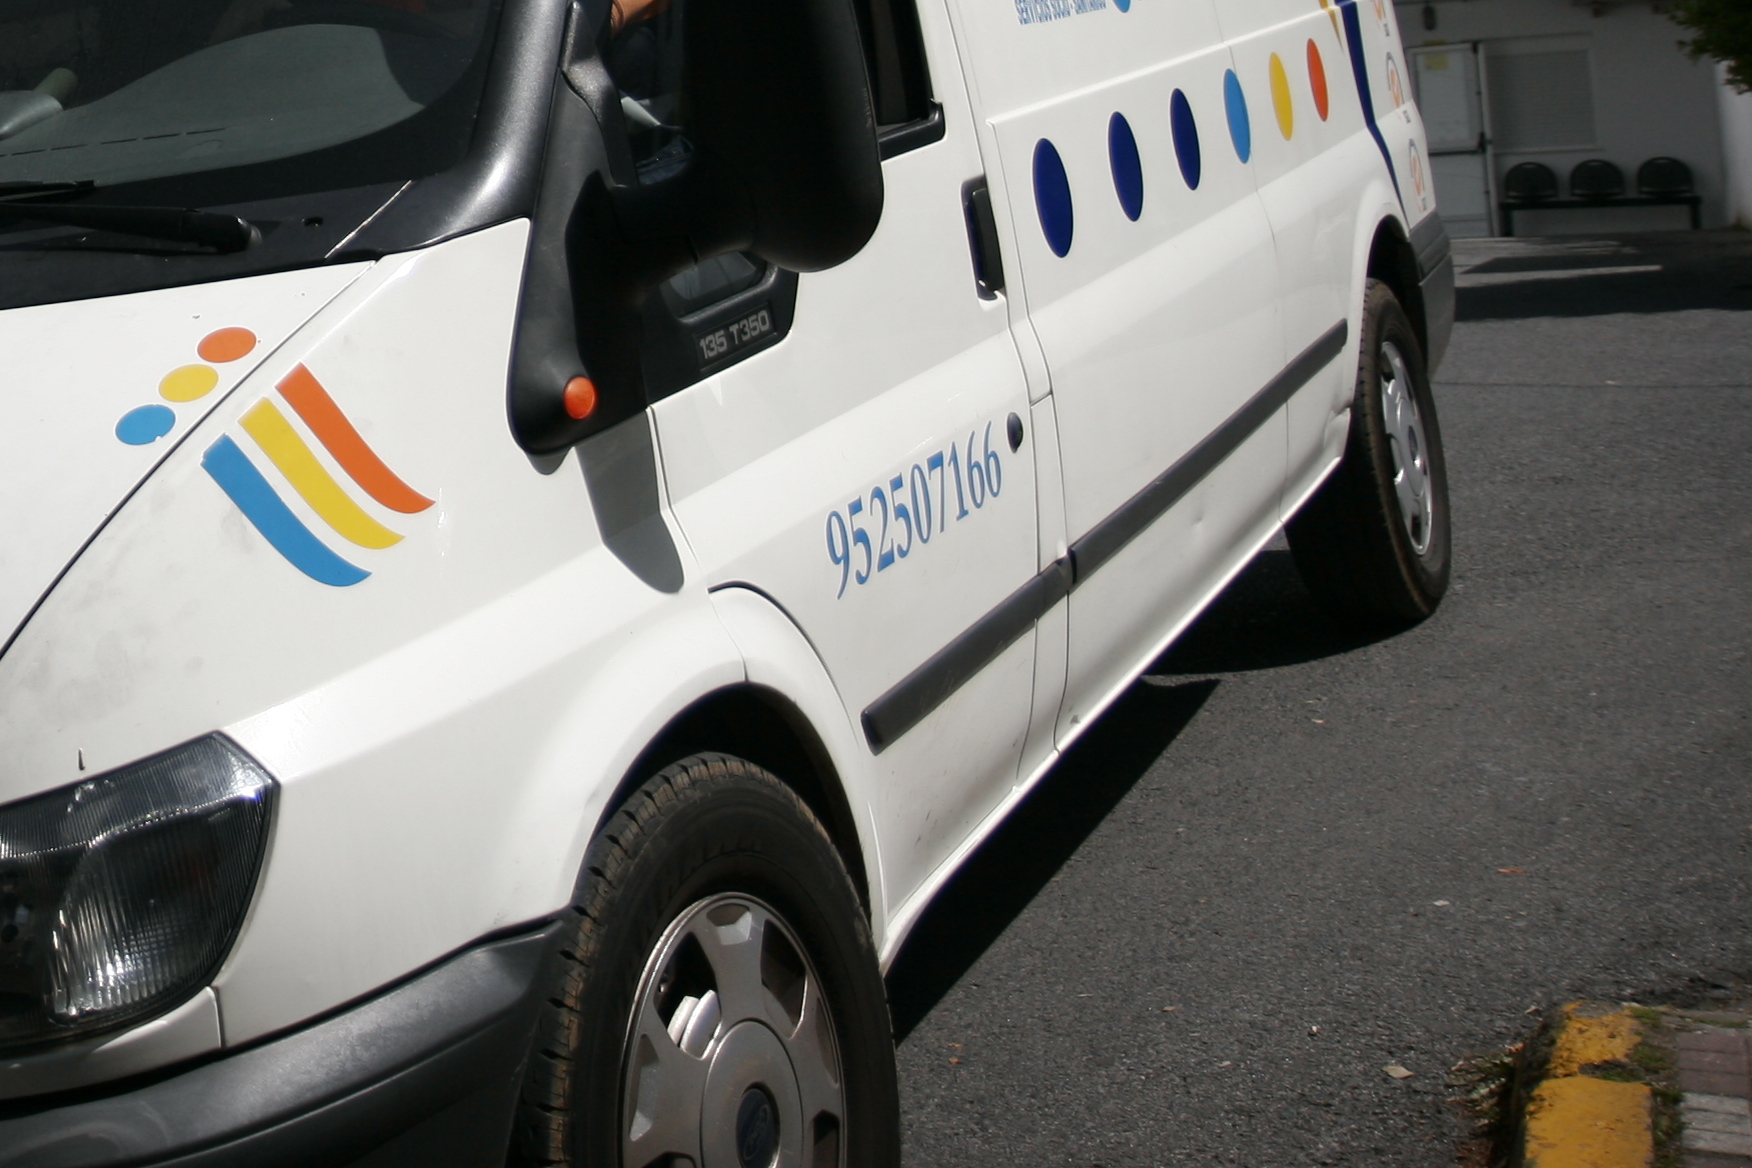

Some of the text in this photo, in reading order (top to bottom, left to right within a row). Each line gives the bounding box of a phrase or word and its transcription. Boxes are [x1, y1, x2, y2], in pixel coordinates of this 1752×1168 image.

[699, 310, 770, 359] 135 T350
[825, 420, 1003, 600] 952507166
